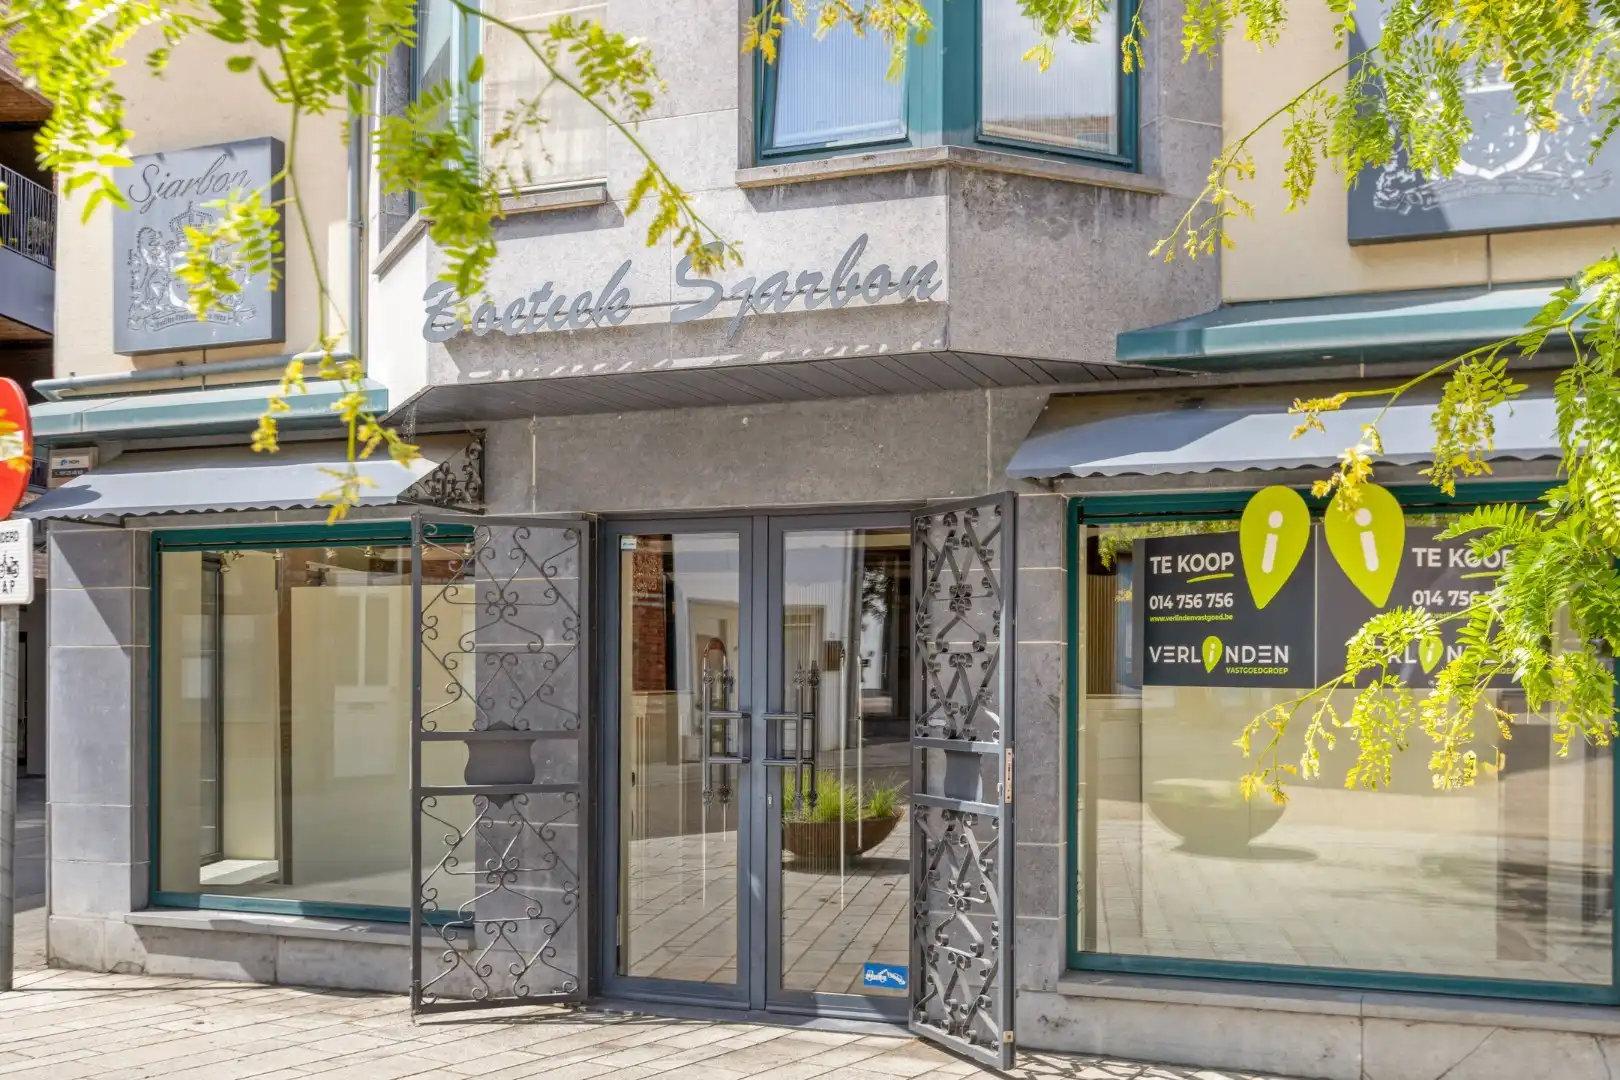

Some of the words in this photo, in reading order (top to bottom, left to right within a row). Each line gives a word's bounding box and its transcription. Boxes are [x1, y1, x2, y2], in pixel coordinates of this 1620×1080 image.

[129, 154, 251, 214] Sjarbon
[670, 233, 943, 346] Sjarbon
[1150, 556, 1172, 574] TE
[1177, 552, 1234, 573] KOOP
[1412, 548, 1442, 567] TE
[1149, 595, 1173, 610] 014
[1176, 594, 1203, 609] 756
[1206, 592, 1234, 608] 756
[1412, 590, 1444, 606] 014
[1149, 613, 1233, 622] www.verlindenvastgoed.be
[1226, 667, 1289, 675] VASTGOEDGROEP
